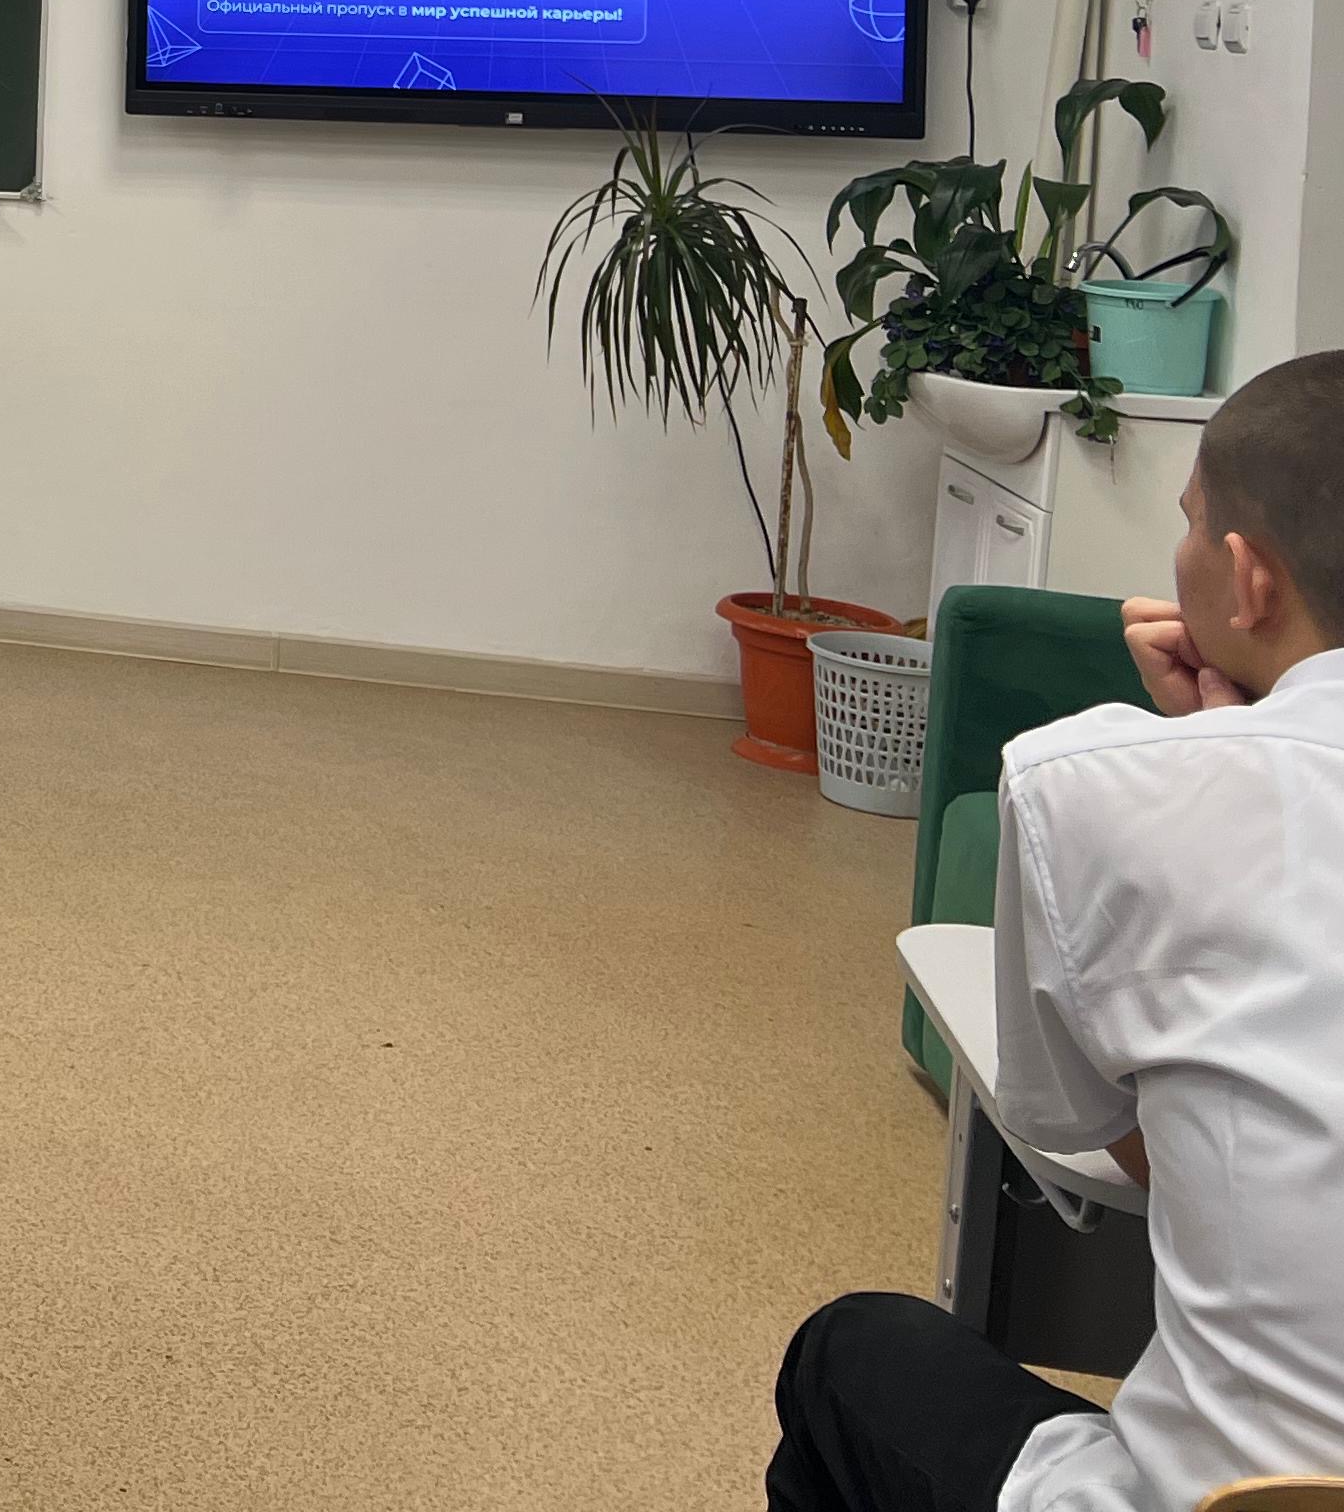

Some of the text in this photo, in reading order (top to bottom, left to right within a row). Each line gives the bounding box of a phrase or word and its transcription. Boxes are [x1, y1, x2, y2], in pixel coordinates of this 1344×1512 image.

[327, 3, 395, 19] пропуск
[399, 5, 408, 16] в
[411, 5, 447, 21] мир
[449, 3, 537, 22] успешной
[542, 6, 623, 23] карьеры!
